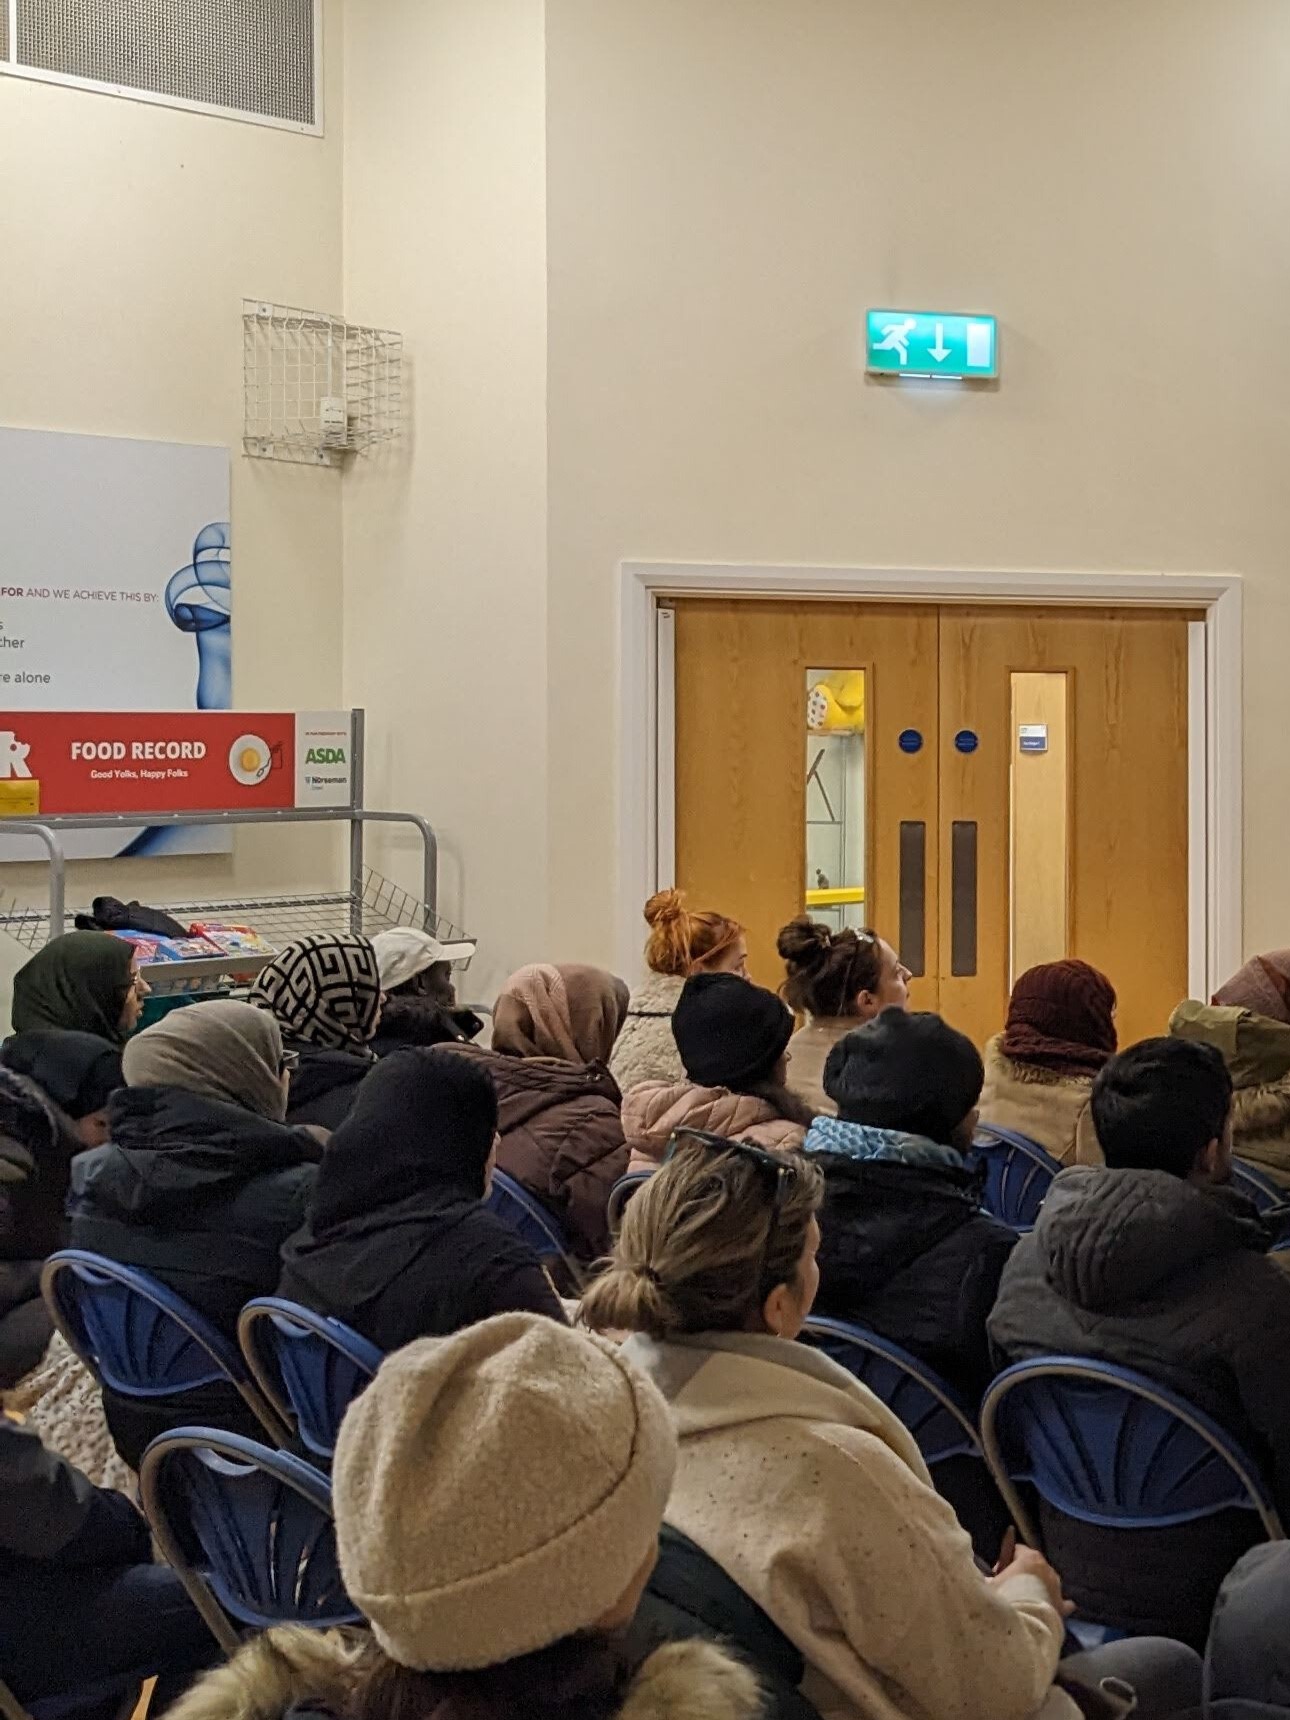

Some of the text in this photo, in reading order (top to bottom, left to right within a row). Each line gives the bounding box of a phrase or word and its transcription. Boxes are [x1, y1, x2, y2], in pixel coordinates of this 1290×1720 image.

[1, 587, 159, 602] FOR AND WE ACHIEVE THIS BY:
[14, 671, 51, 684] alone
[71, 741, 206, 760] FOOD RECORD
[305, 748, 346, 764] ASDA
[91, 769, 113, 779] Good
[140, 769, 165, 779] Happy
